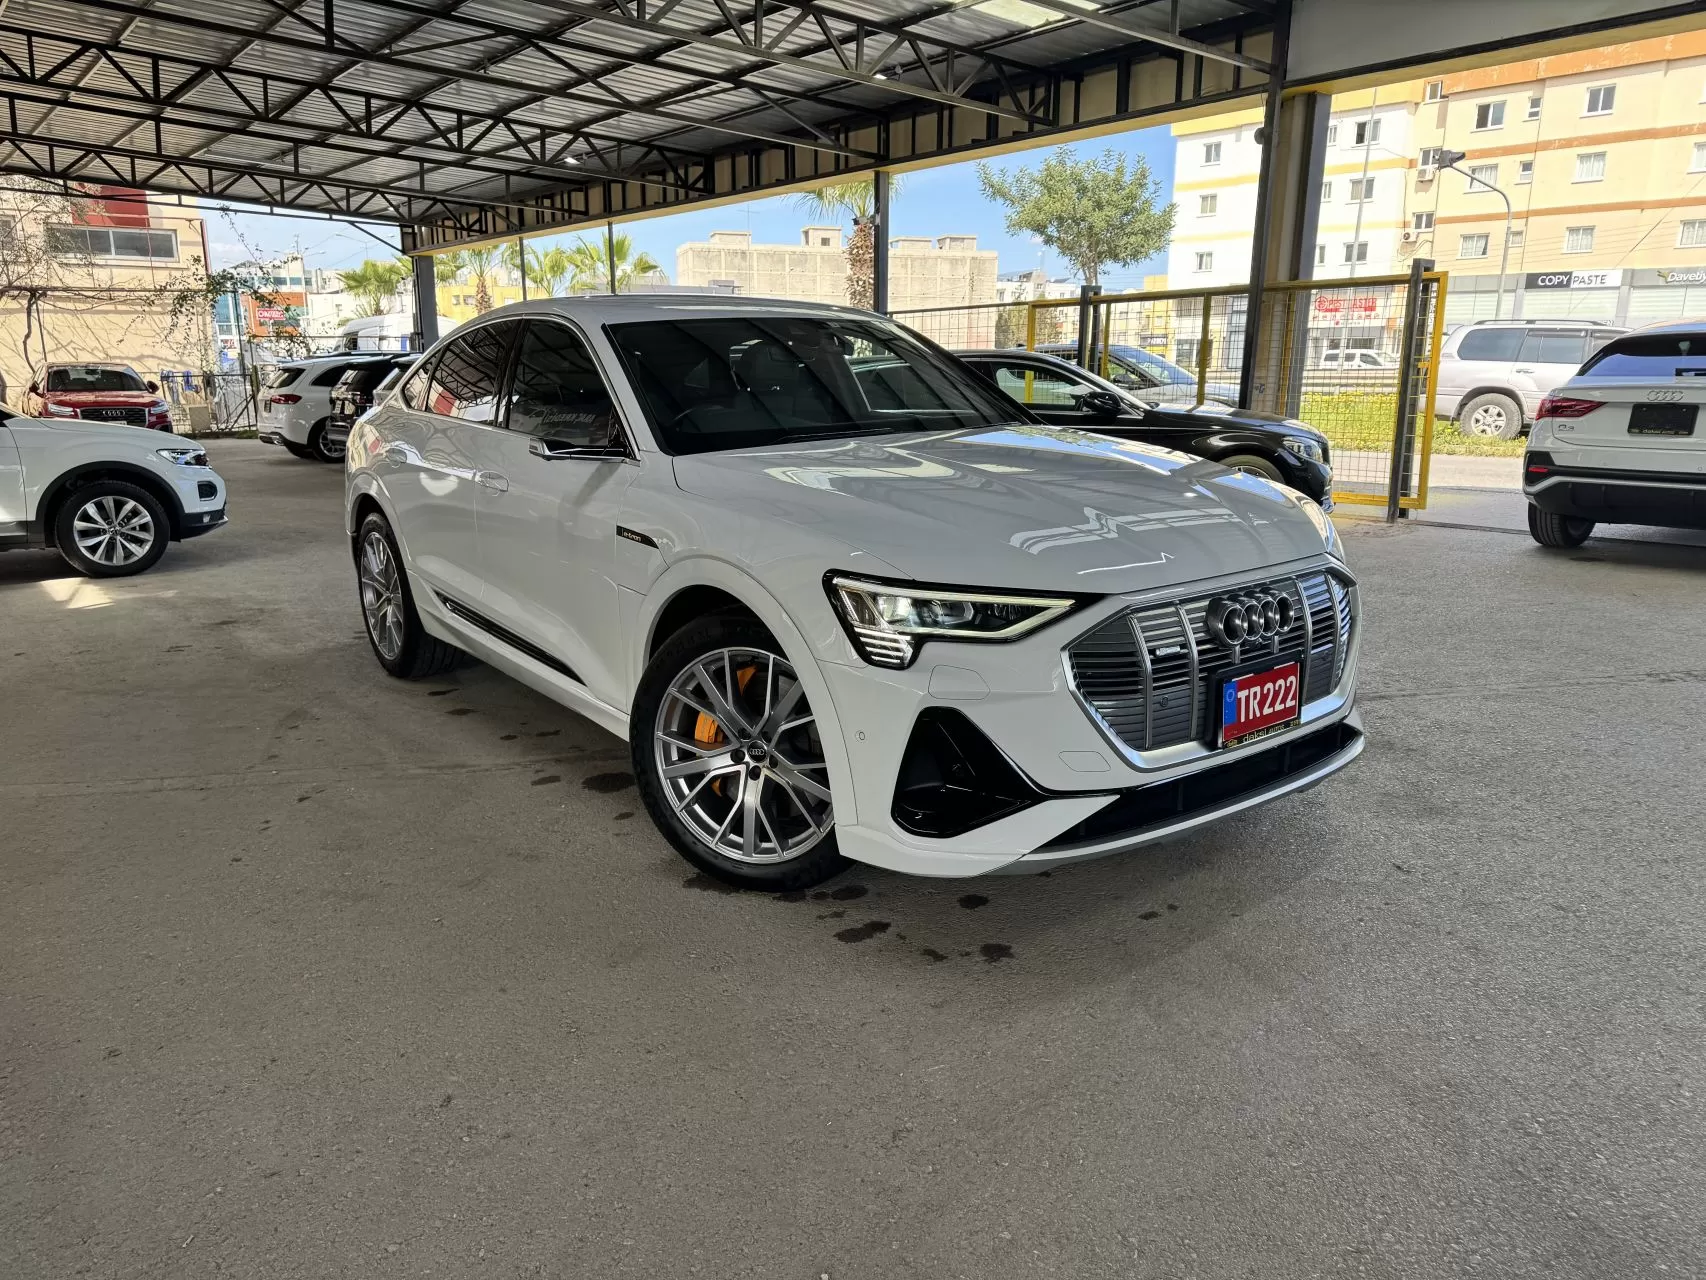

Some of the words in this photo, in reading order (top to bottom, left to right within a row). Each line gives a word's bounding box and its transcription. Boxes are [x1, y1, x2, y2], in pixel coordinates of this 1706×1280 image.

[1537, 274, 1570, 286] COPY
[1572, 274, 1608, 285] PASTE
[623, 531, 642, 542] e-tron
